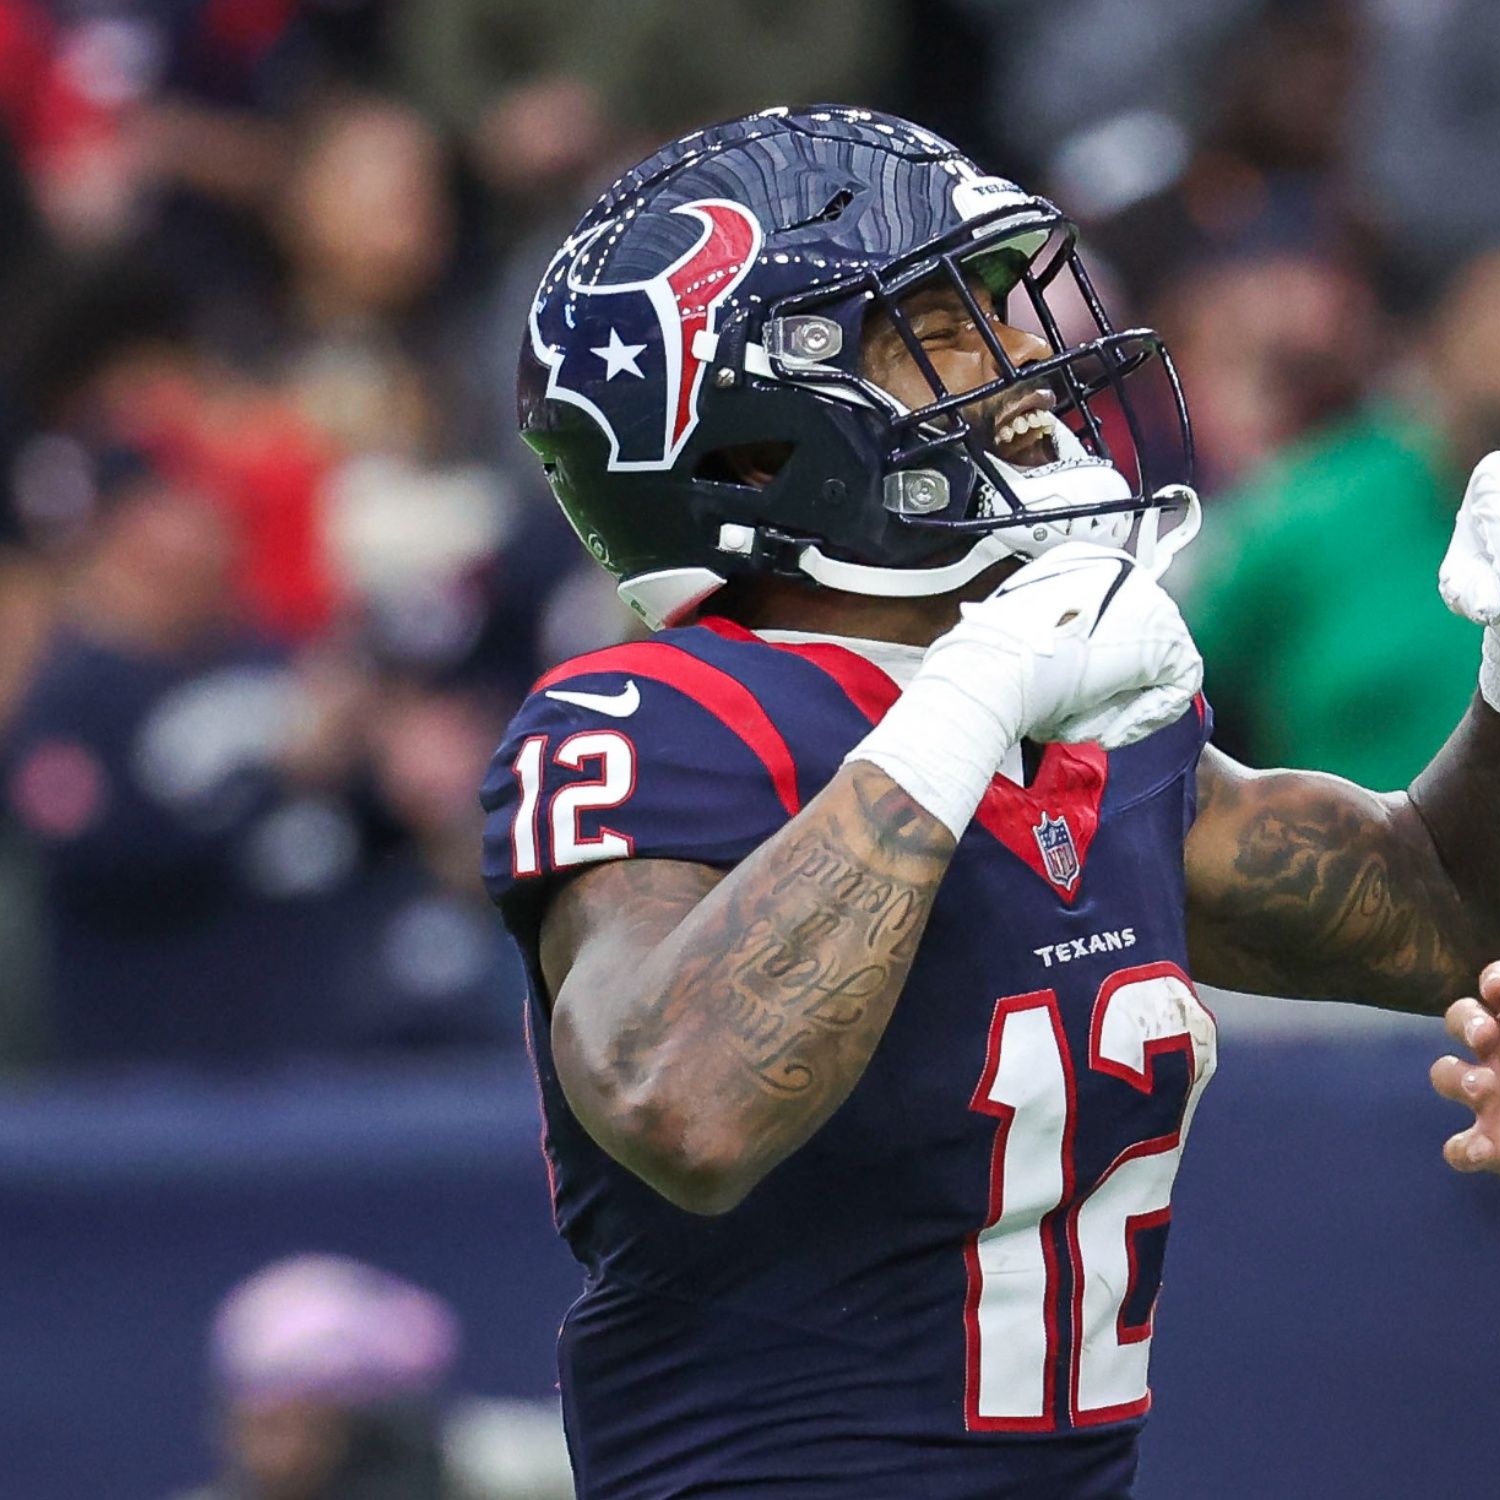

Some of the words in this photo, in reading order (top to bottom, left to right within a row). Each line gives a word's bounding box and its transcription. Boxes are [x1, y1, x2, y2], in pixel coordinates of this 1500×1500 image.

[510, 728, 638, 879] 12
[1033, 927, 1137, 968] TEXANS
[963, 960, 1218, 1432] 12
